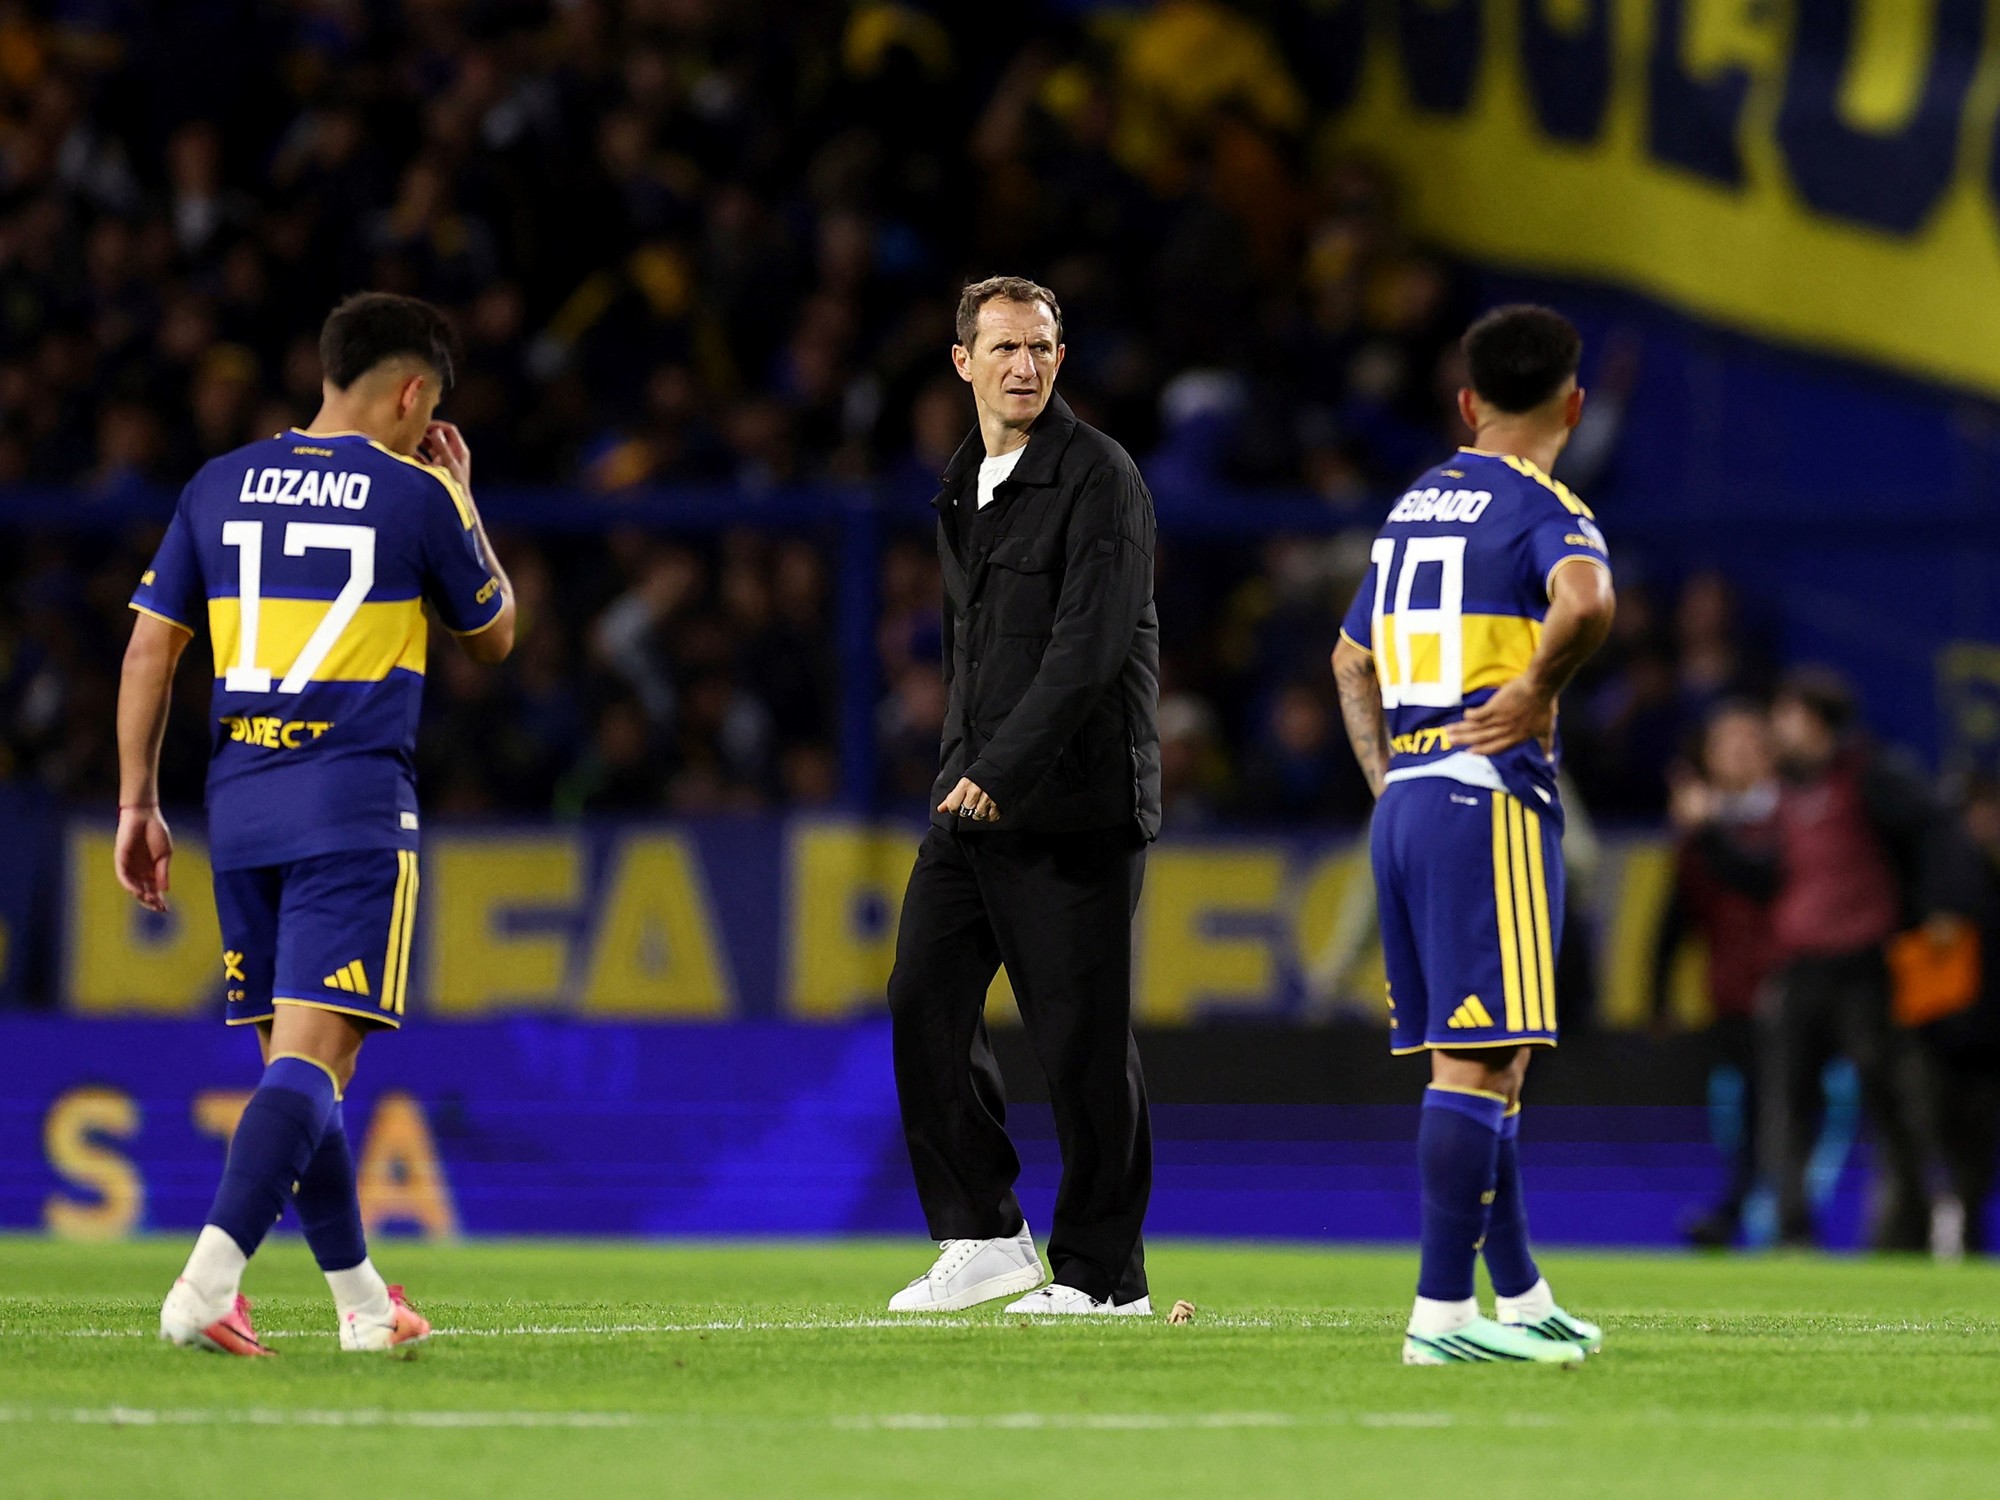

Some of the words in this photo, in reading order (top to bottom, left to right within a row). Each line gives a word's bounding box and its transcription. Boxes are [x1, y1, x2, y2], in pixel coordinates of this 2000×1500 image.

[239, 467, 371, 510] LOZANO
[223, 520, 376, 694] 17
[1371, 536, 1467, 709] 18
